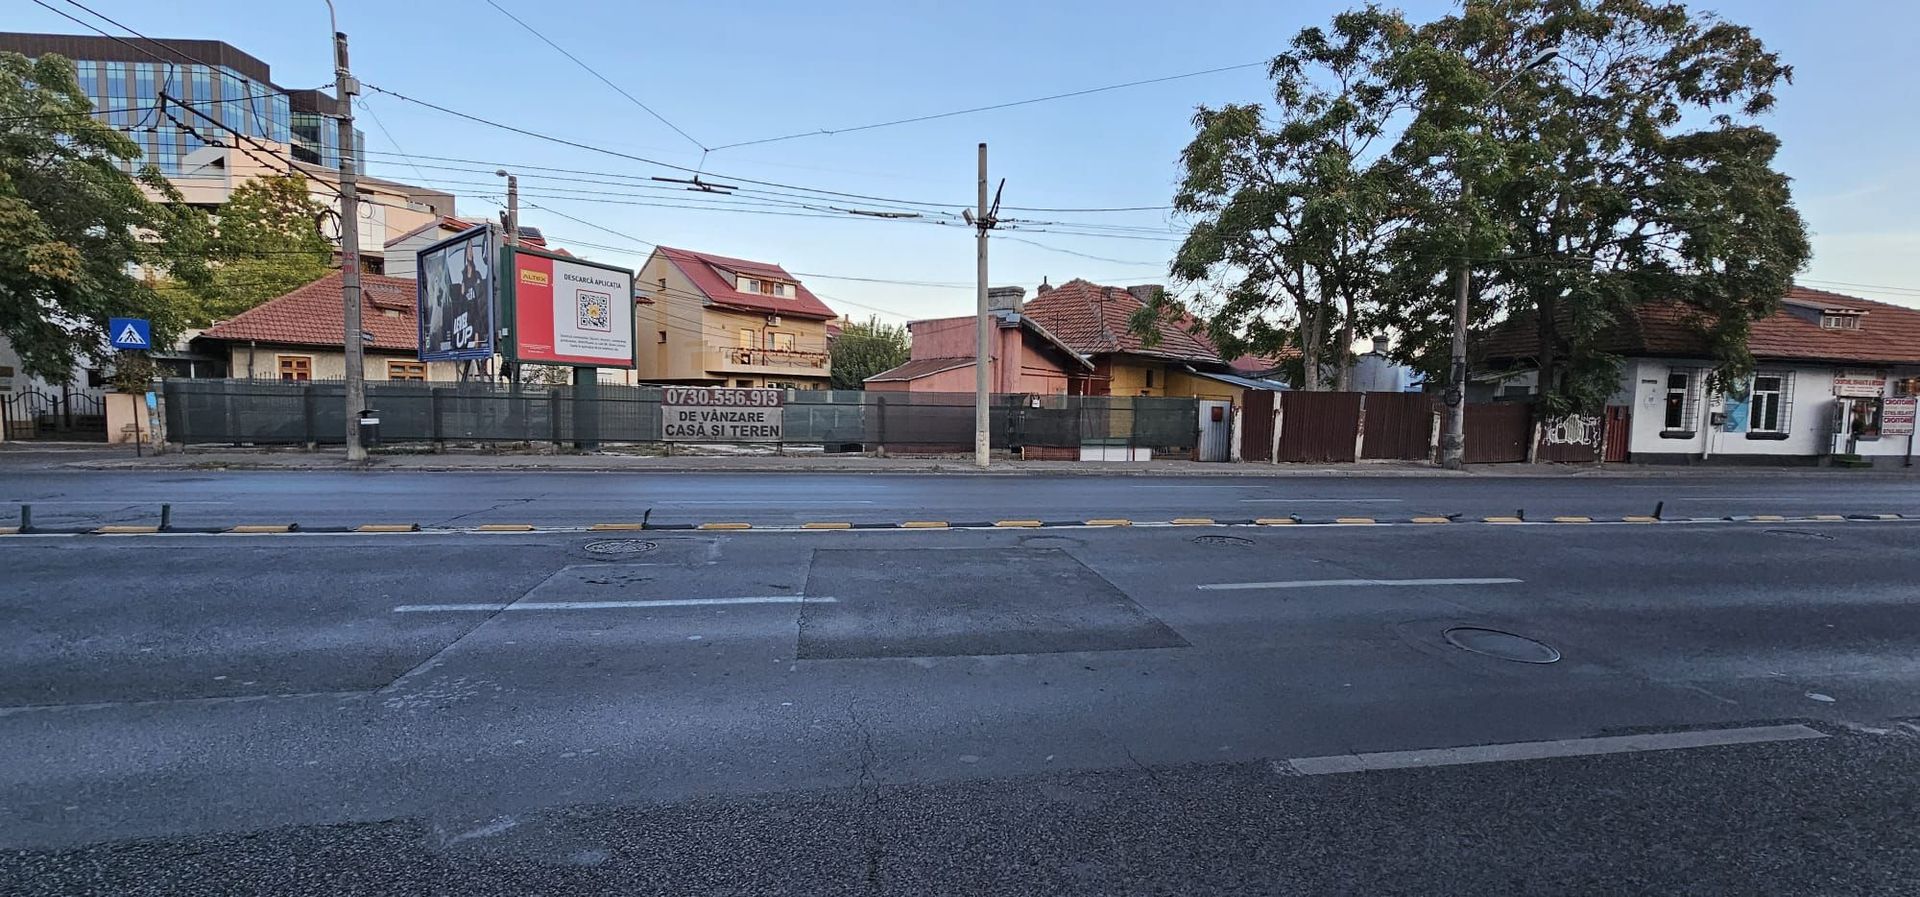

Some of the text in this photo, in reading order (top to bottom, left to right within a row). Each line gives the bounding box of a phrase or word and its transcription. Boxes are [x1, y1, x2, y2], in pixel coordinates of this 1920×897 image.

[456, 325, 473, 348] UP
[666, 389, 778, 406] 0730.556.913
[679, 409, 765, 422] DE VÂNZARE
[665, 422, 706, 436] CASĂ
[730, 425, 779, 437] TEREN
